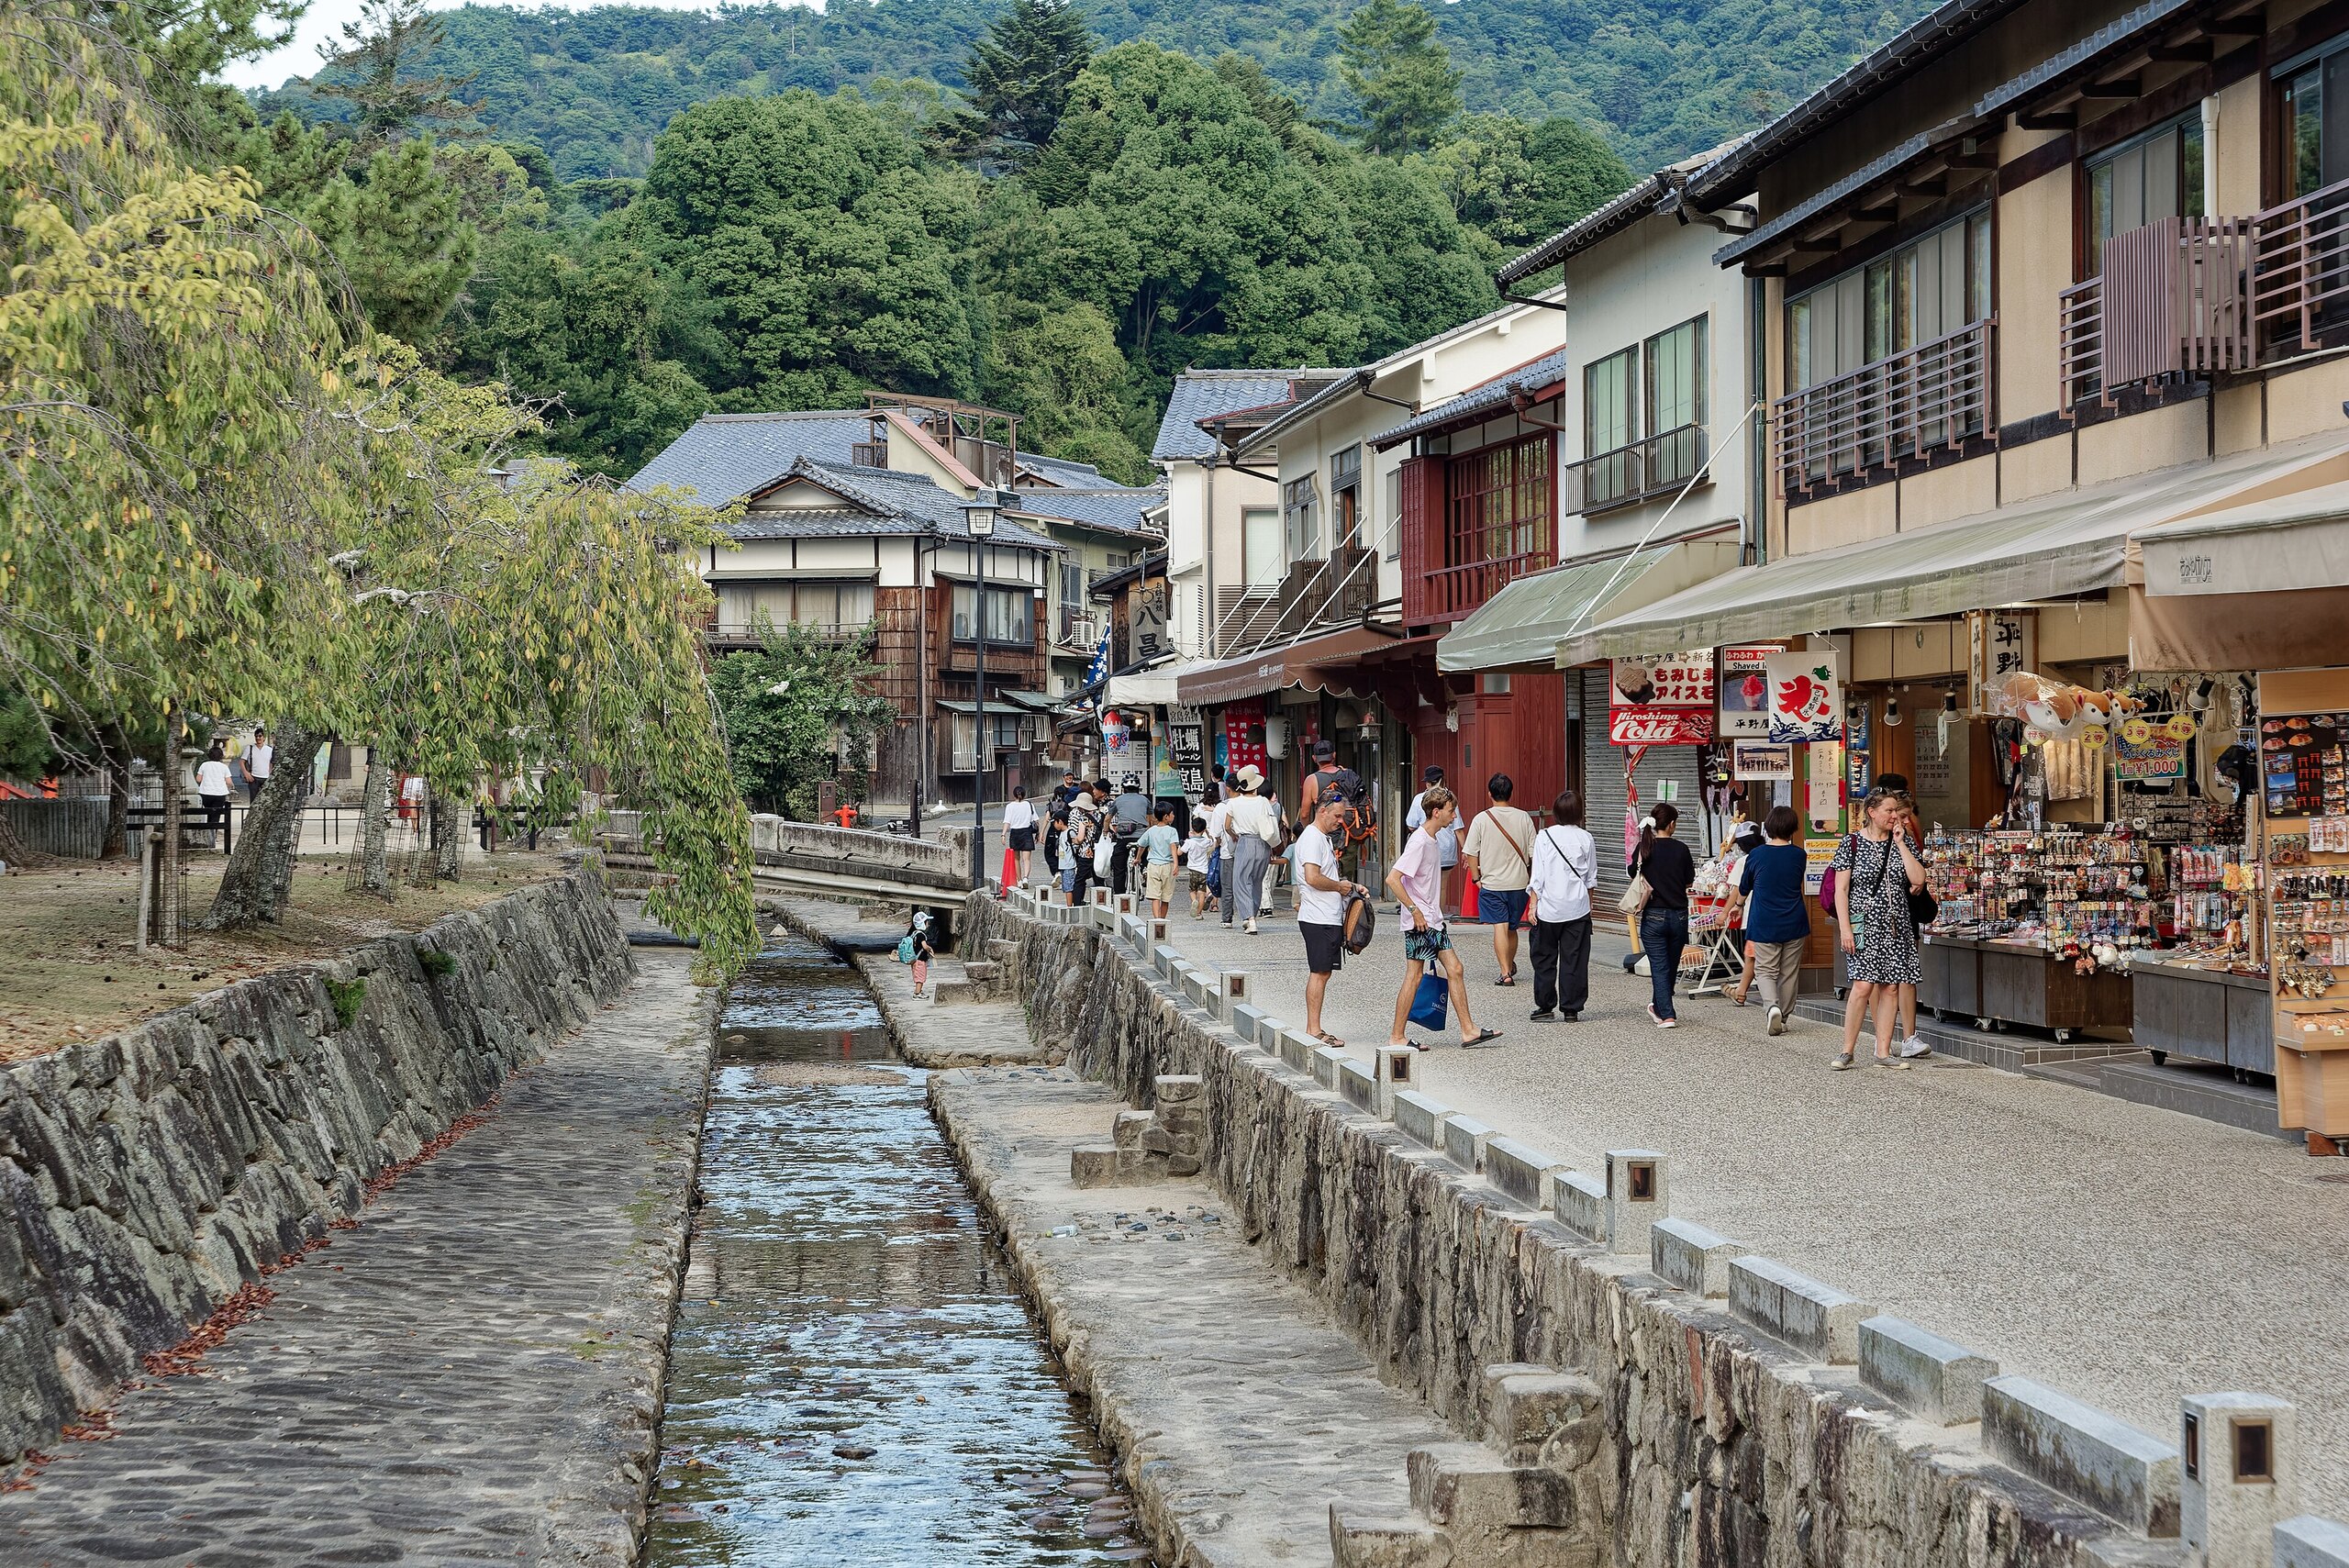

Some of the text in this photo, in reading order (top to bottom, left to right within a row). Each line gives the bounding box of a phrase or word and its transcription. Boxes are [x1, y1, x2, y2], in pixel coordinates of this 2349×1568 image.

[1135, 605, 1163, 658] 八昌
[1726, 651, 1753, 660] ふわふわ
[1994, 622, 2024, 675] 平野
[1973, 624, 1981, 708] 平野屋
[1613, 711, 1680, 725] Hiroshima
[1172, 728, 1200, 751] 牡蠣
[1611, 720, 1679, 742] Cola
[1178, 767, 1205, 792] 宮島
[1851, 761, 1861, 792] JAPAN
[2136, 760, 2177, 775] ¥1,000
